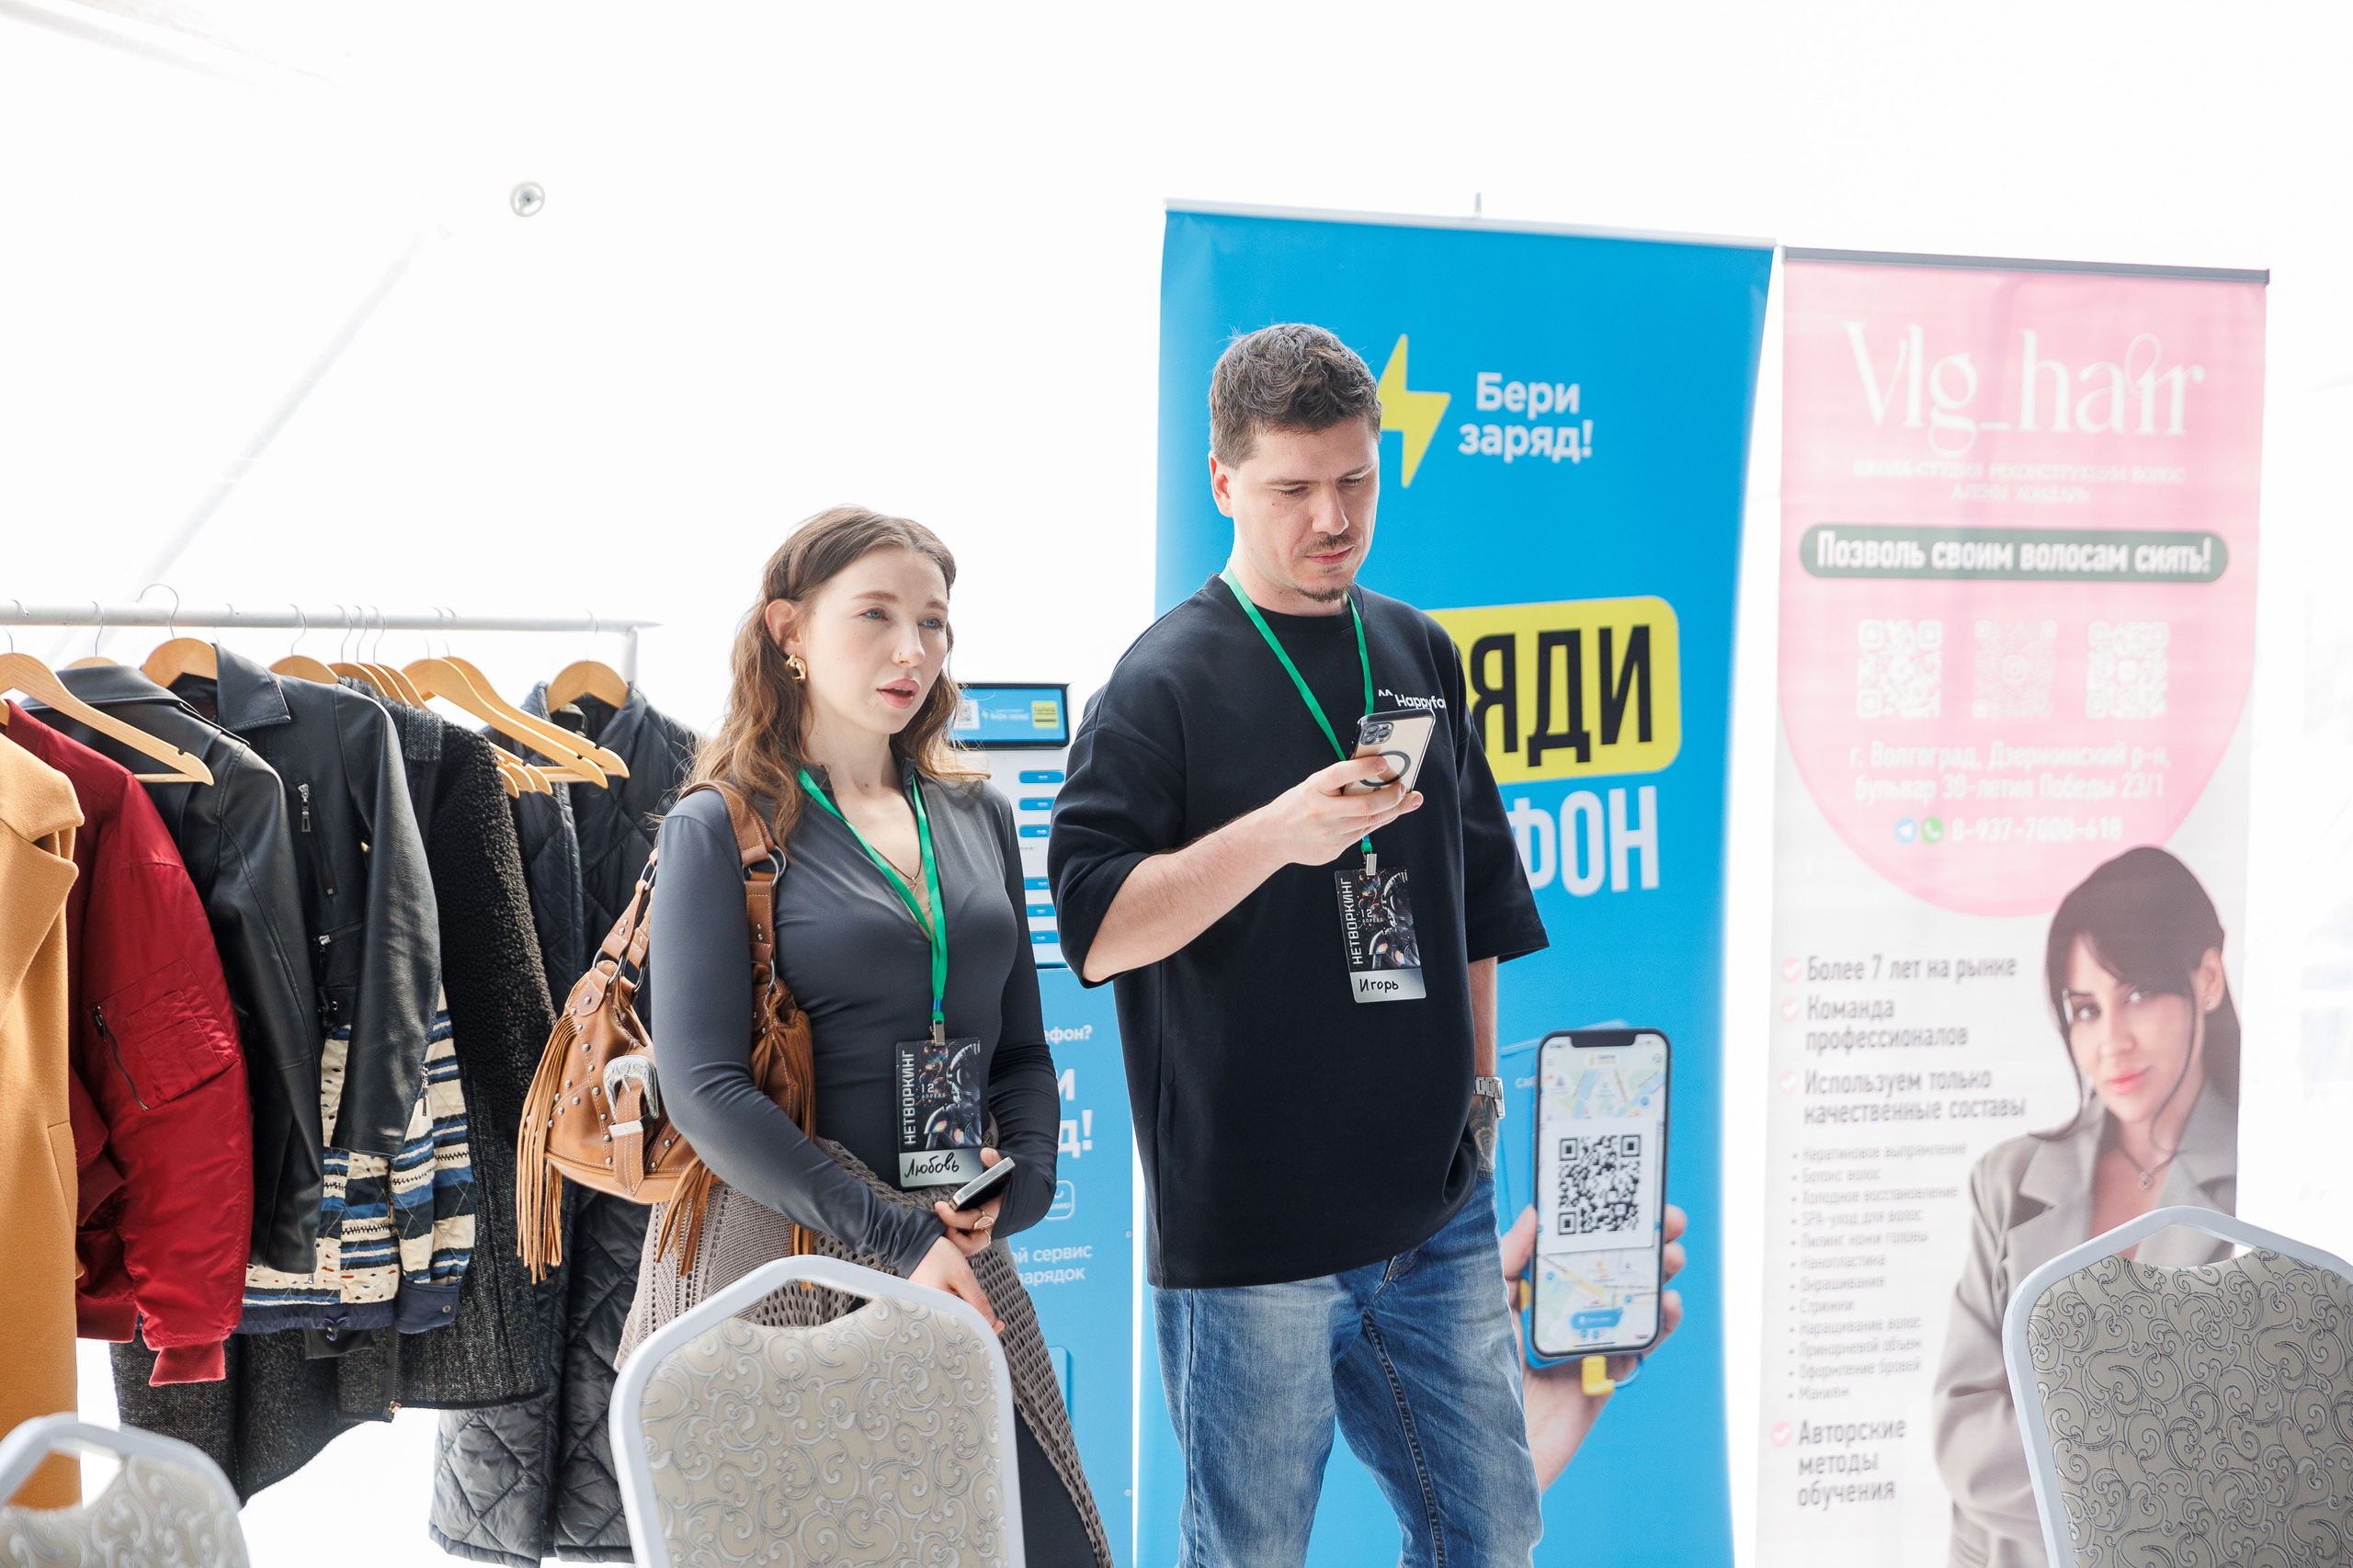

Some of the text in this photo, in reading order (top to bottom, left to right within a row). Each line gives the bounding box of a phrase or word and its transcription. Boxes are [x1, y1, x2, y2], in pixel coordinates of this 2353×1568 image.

[1476, 371, 1580, 420] Бери
[1843, 320, 2206, 458] Vlg_hair
[1459, 419, 1593, 463] заряд!
[1816, 530, 2213, 575] Позволь своим волосам сиять!
[1453, 623, 1653, 767] ЯДИ
[1848, 749, 1864, 767] г.
[1870, 742, 1982, 771] Волгоград,
[1987, 741, 2127, 771] Дзержинский
[1854, 771, 2165, 805] бульвар 30-летия Победы 23/1
[1950, 816, 2123, 842] 8-937-7000-618
[1341, 878, 1364, 965] НЕТВОРКИНГ
[1360, 909, 1373, 918] 12
[1807, 954, 2017, 983] Более 7 лет на рынке
[1359, 978, 1399, 993] Игорь
[1807, 994, 1894, 1021] Команда
[1805, 1024, 1968, 1056] профессионалов
[902, 1050, 916, 1145] НЕТВОРКИНГ
[921, 1084, 935, 1093] 12
[1804, 1068, 1992, 1097] Используем только
[1803, 1096, 2028, 1125] качественные составы
[904, 1152, 960, 1177] Любовь
[1033, 1244, 1093, 1264] сервис
[1798, 1419, 1906, 1449] Авторские
[1798, 1449, 1879, 1476] методы
[1797, 1481, 1895, 1512] обучения
